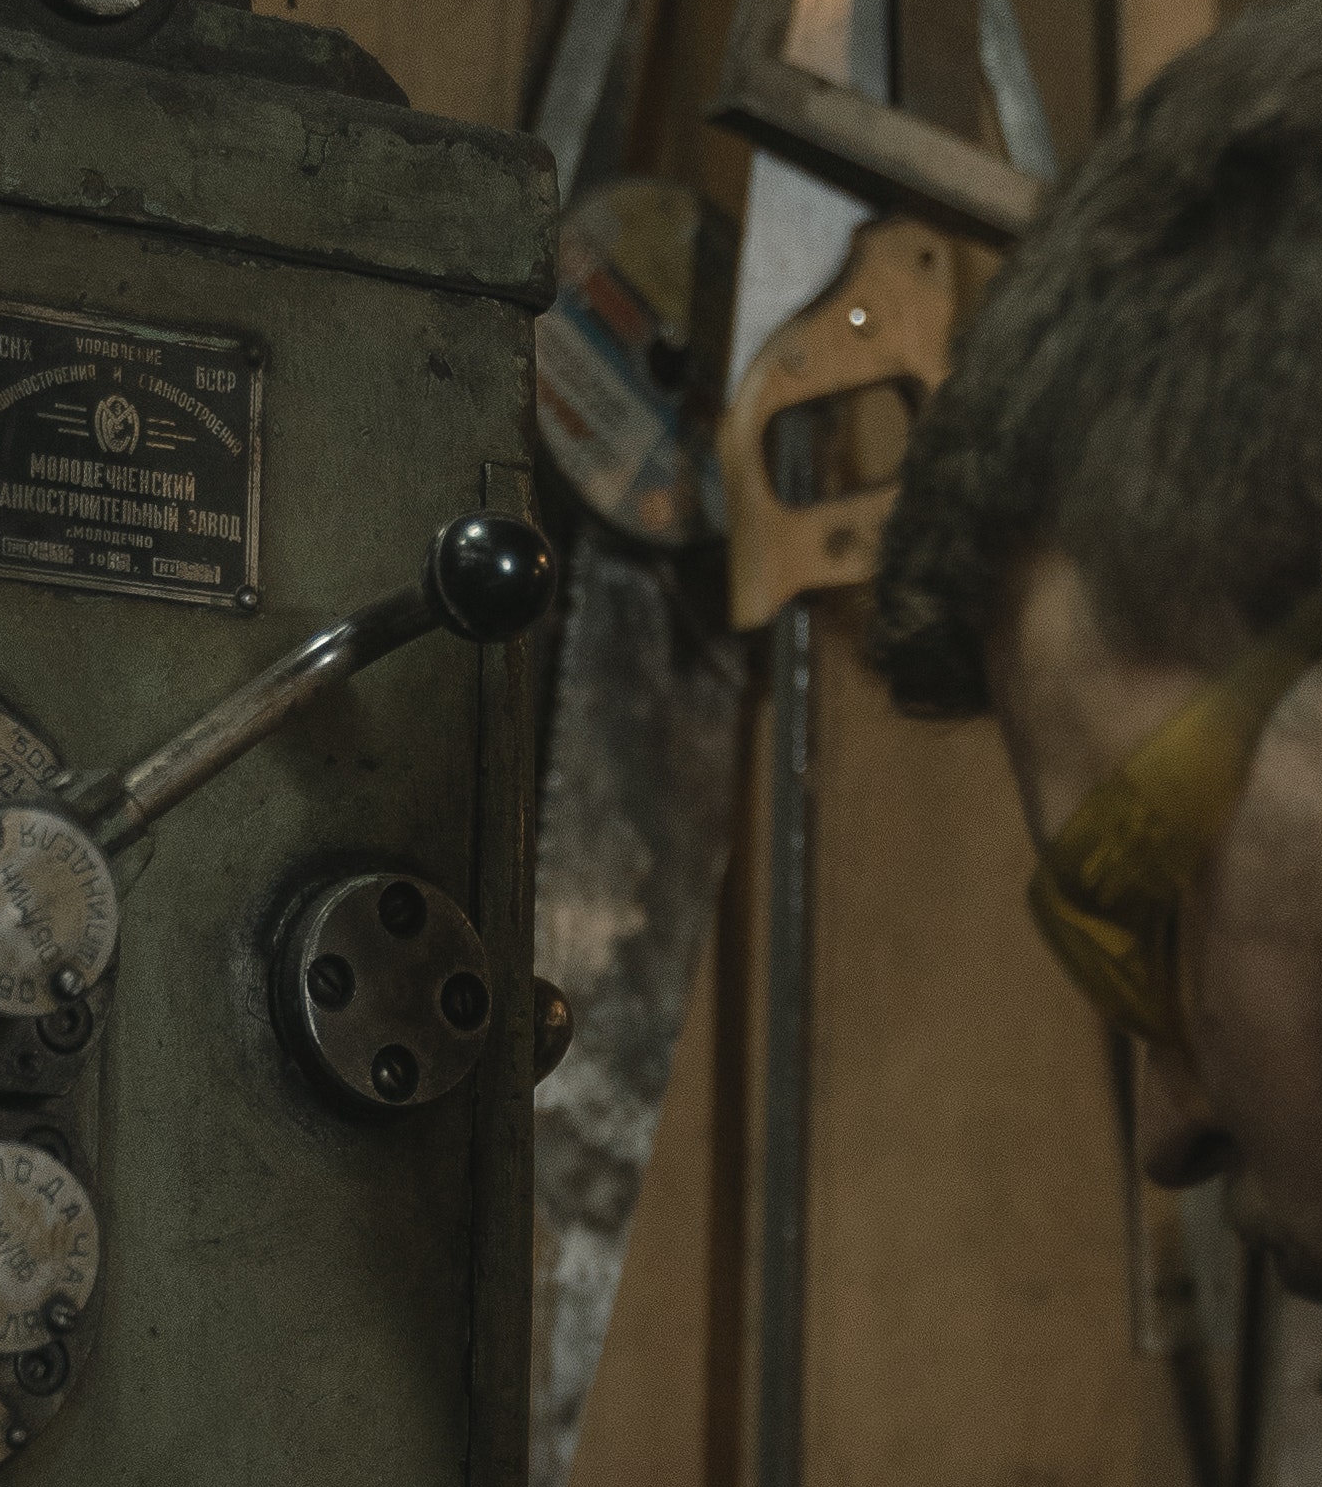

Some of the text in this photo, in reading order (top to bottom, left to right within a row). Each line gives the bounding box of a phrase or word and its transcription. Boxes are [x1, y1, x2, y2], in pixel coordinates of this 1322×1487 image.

[75, 336, 163, 366] УПРАВЛЕНИЕ
[195, 365, 237, 394] БССР
[138, 372, 244, 458] СТАНКОСТРОЕНИЯ
[29, 452, 197, 502] МОЛОДЕЧНЕНСКИЙ
[187, 508, 243, 543] ЗАВОД
